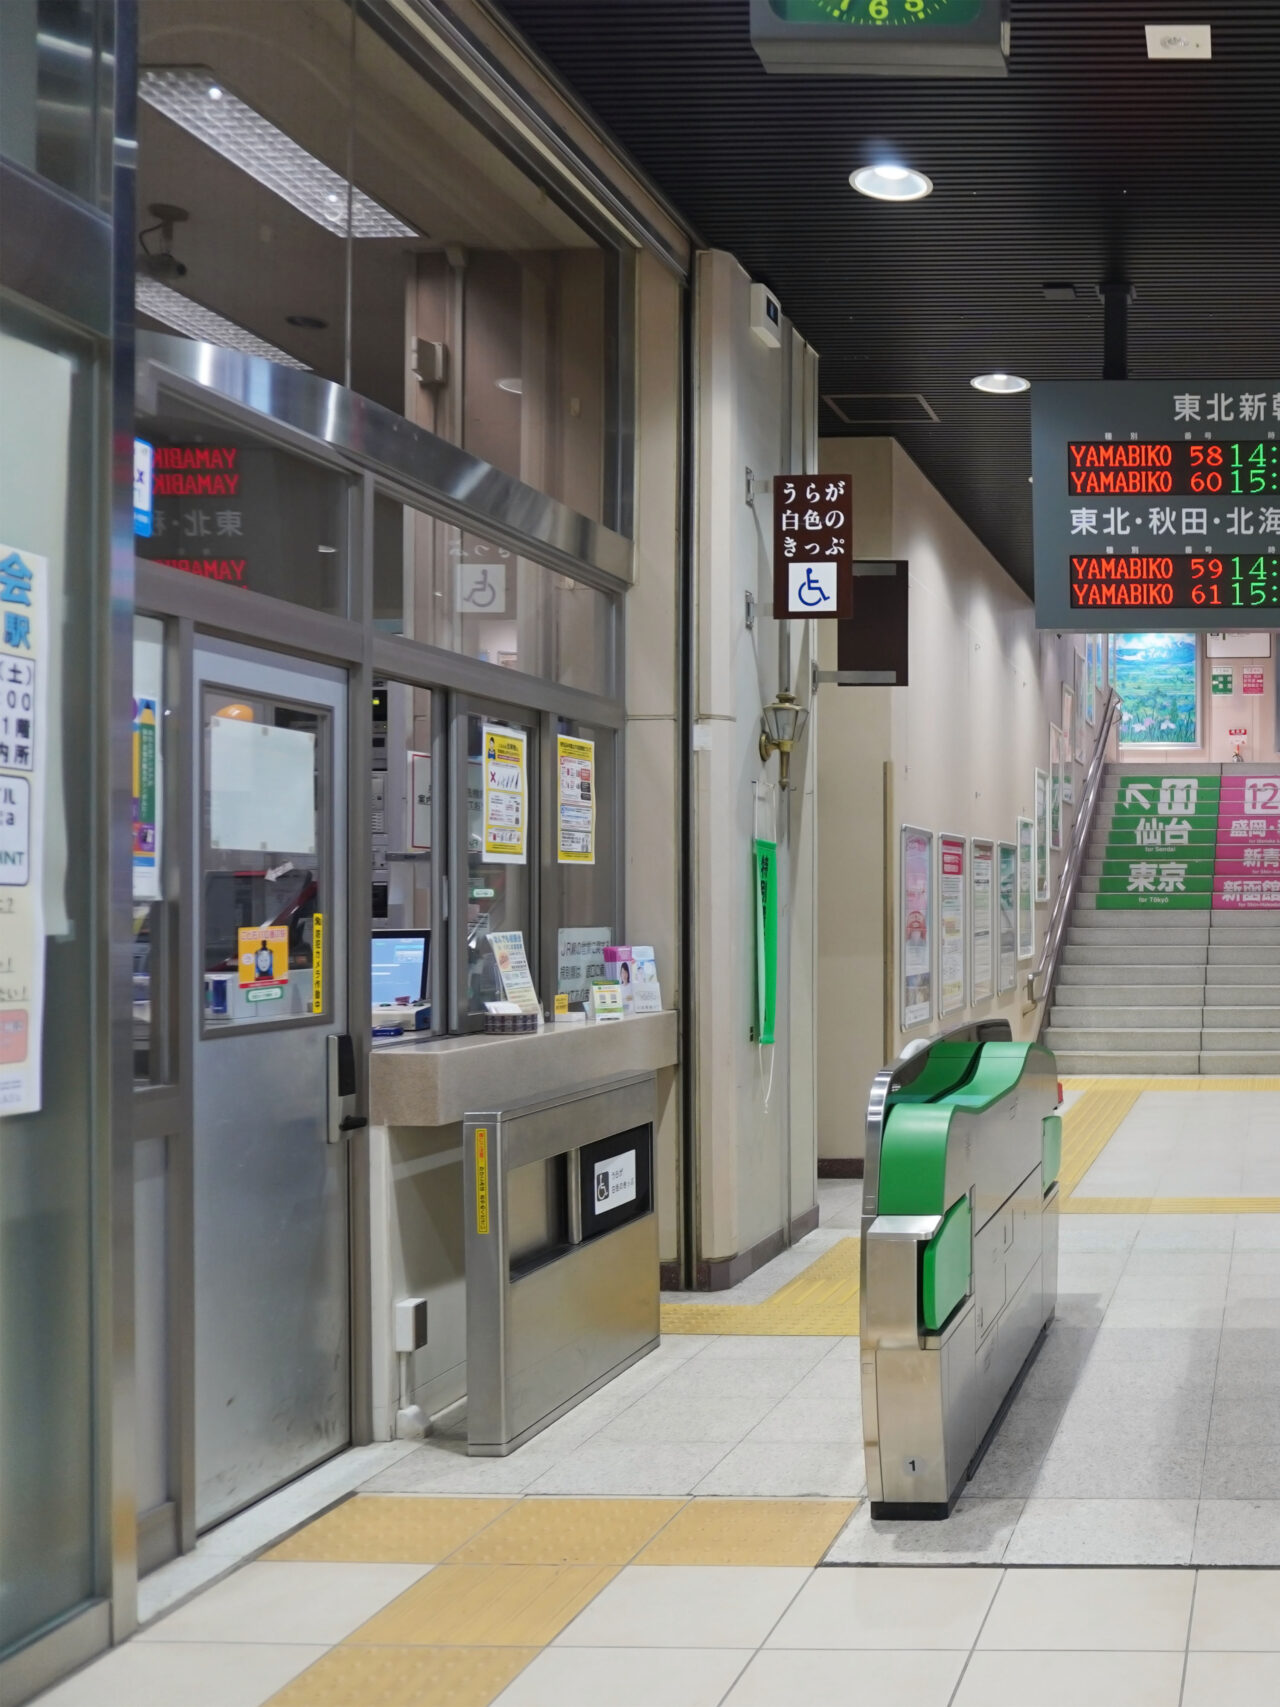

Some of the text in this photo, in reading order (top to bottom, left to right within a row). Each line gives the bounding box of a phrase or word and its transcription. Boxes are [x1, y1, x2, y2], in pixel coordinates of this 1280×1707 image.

[1070, 445, 1172, 467] YAMABIKO
[1190, 445, 1224, 466] 58
[784, 480, 846, 504] うらが
[1070, 472, 1172, 493] YAMABIKO
[1190, 472, 1222, 493] 60
[782, 510, 845, 531] 白色の
[784, 536, 845, 558] きっぷ
[1072, 558, 1174, 579] YAMABIKO
[1190, 558, 1223, 579] 59
[1072, 584, 1174, 605] YAMABIKO
[1191, 584, 1222, 604] 61
[1250, 783, 1279, 810] 12
[1134, 817, 1192, 846] 仙台
[1126, 862, 1188, 892] 東京
[908, 1460, 916, 1472] 1
